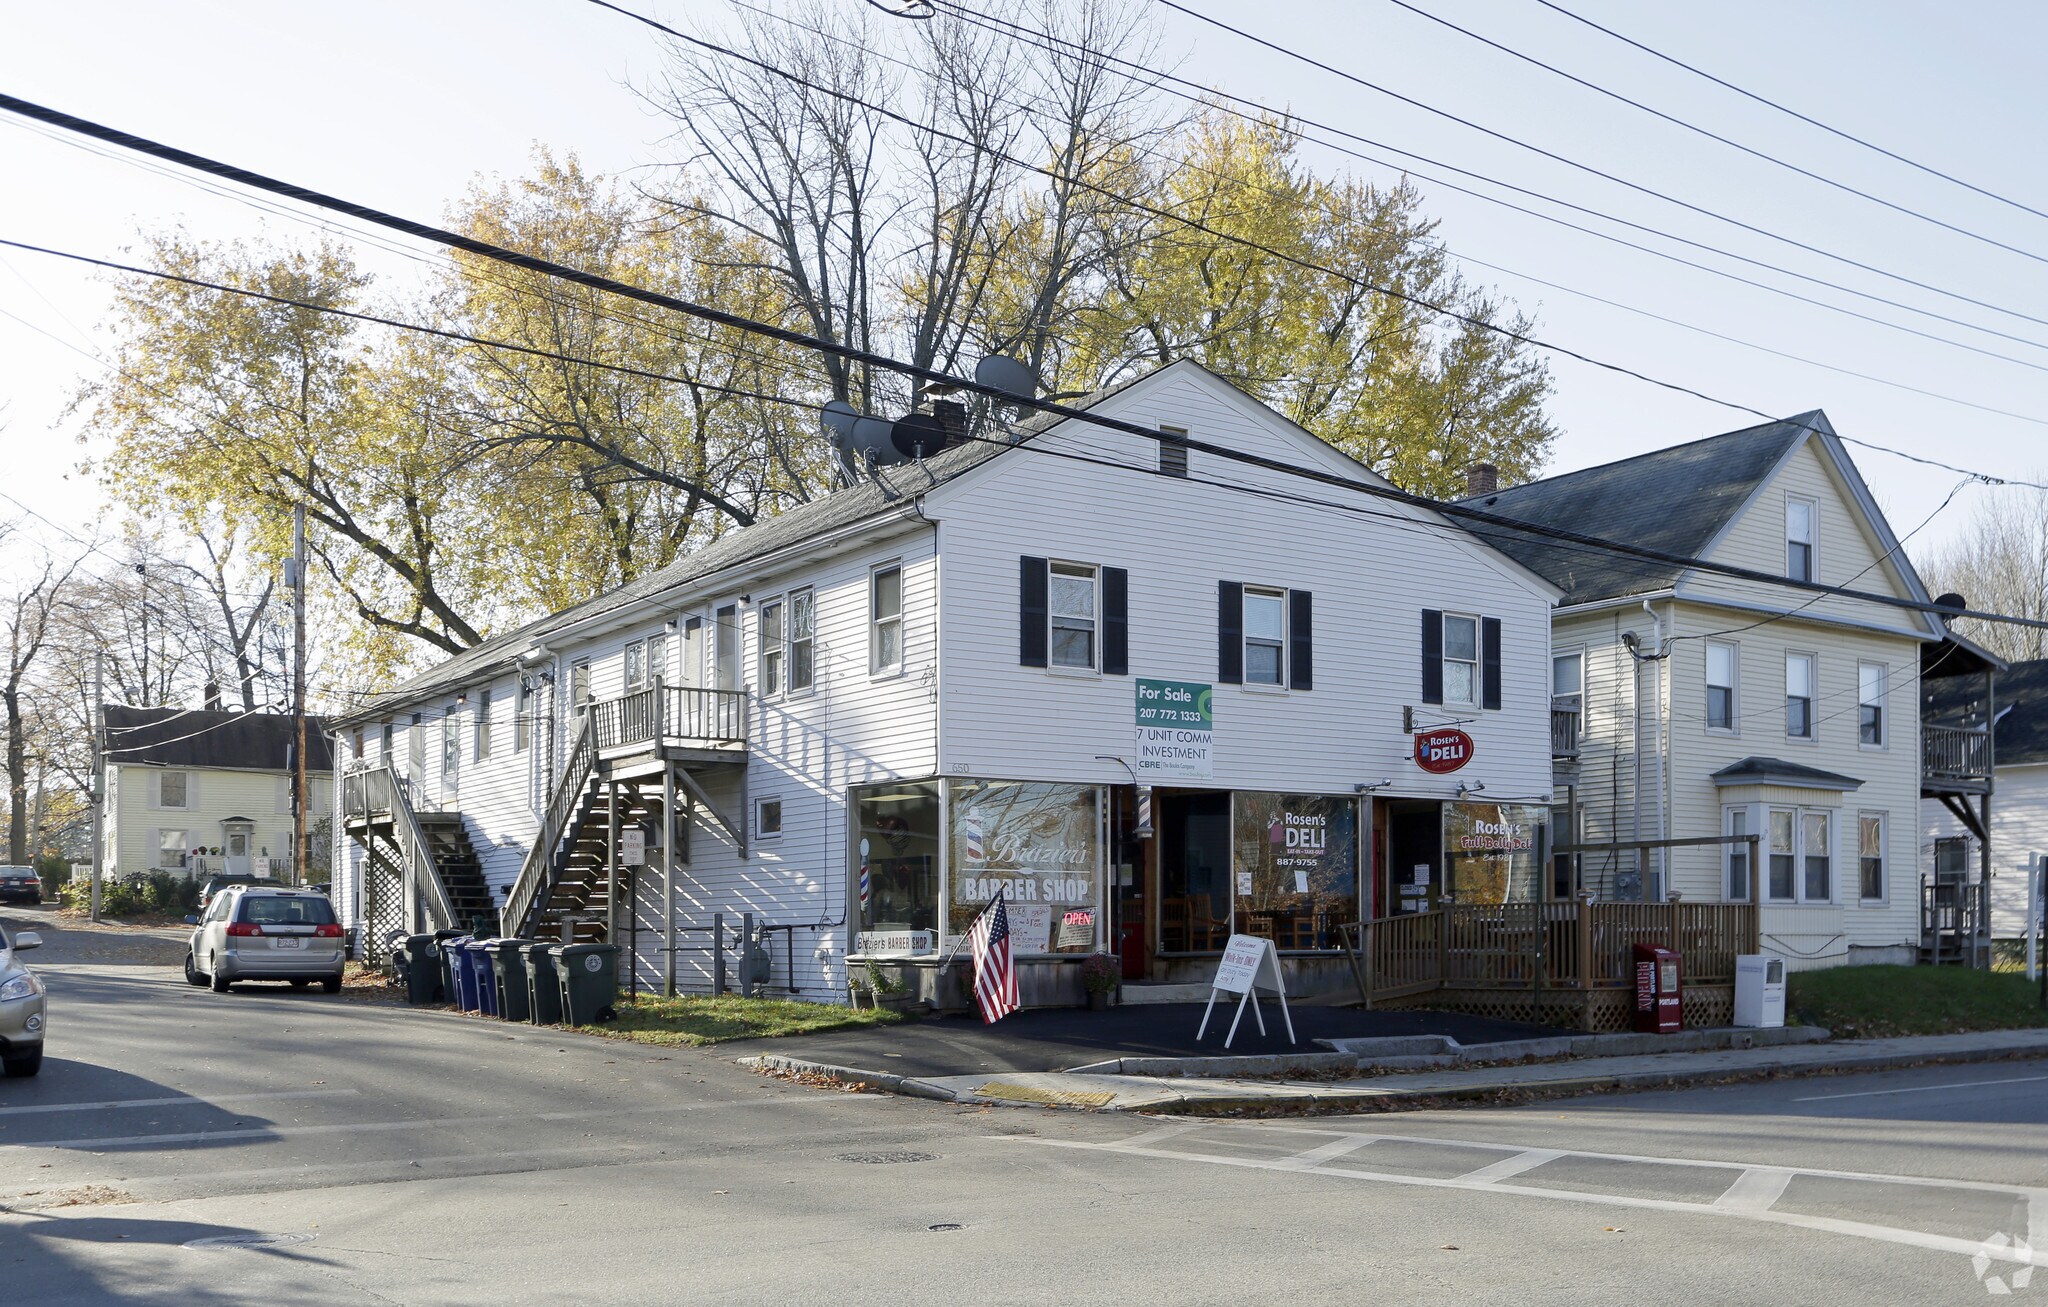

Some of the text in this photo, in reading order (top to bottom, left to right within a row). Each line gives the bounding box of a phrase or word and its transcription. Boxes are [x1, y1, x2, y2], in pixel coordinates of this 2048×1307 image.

[1139, 685, 1192, 702] For Sale
[1140, 708, 1201, 722] 207 772 1333
[1137, 729, 1212, 744] 7 UNIT COMM
[1430, 736, 1458, 745] ROSEN'S
[1142, 746, 1207, 760] INVESTMENT
[1430, 745, 1463, 761] DELI
[952, 763, 969, 773] 650
[1139, 761, 1161, 770] CBRE
[1285, 812, 1325, 825] Rosen's
[1475, 819, 1520, 834] ROSEN'S
[1285, 827, 1325, 847] DELI
[1461, 835, 1532, 853] Full Belly Deli
[965, 878, 1087, 901] BARBER SHOP
[1064, 912, 1090, 925] OPEN
[888, 937, 909, 948] BARBER
[912, 936, 927, 948] SHOP
